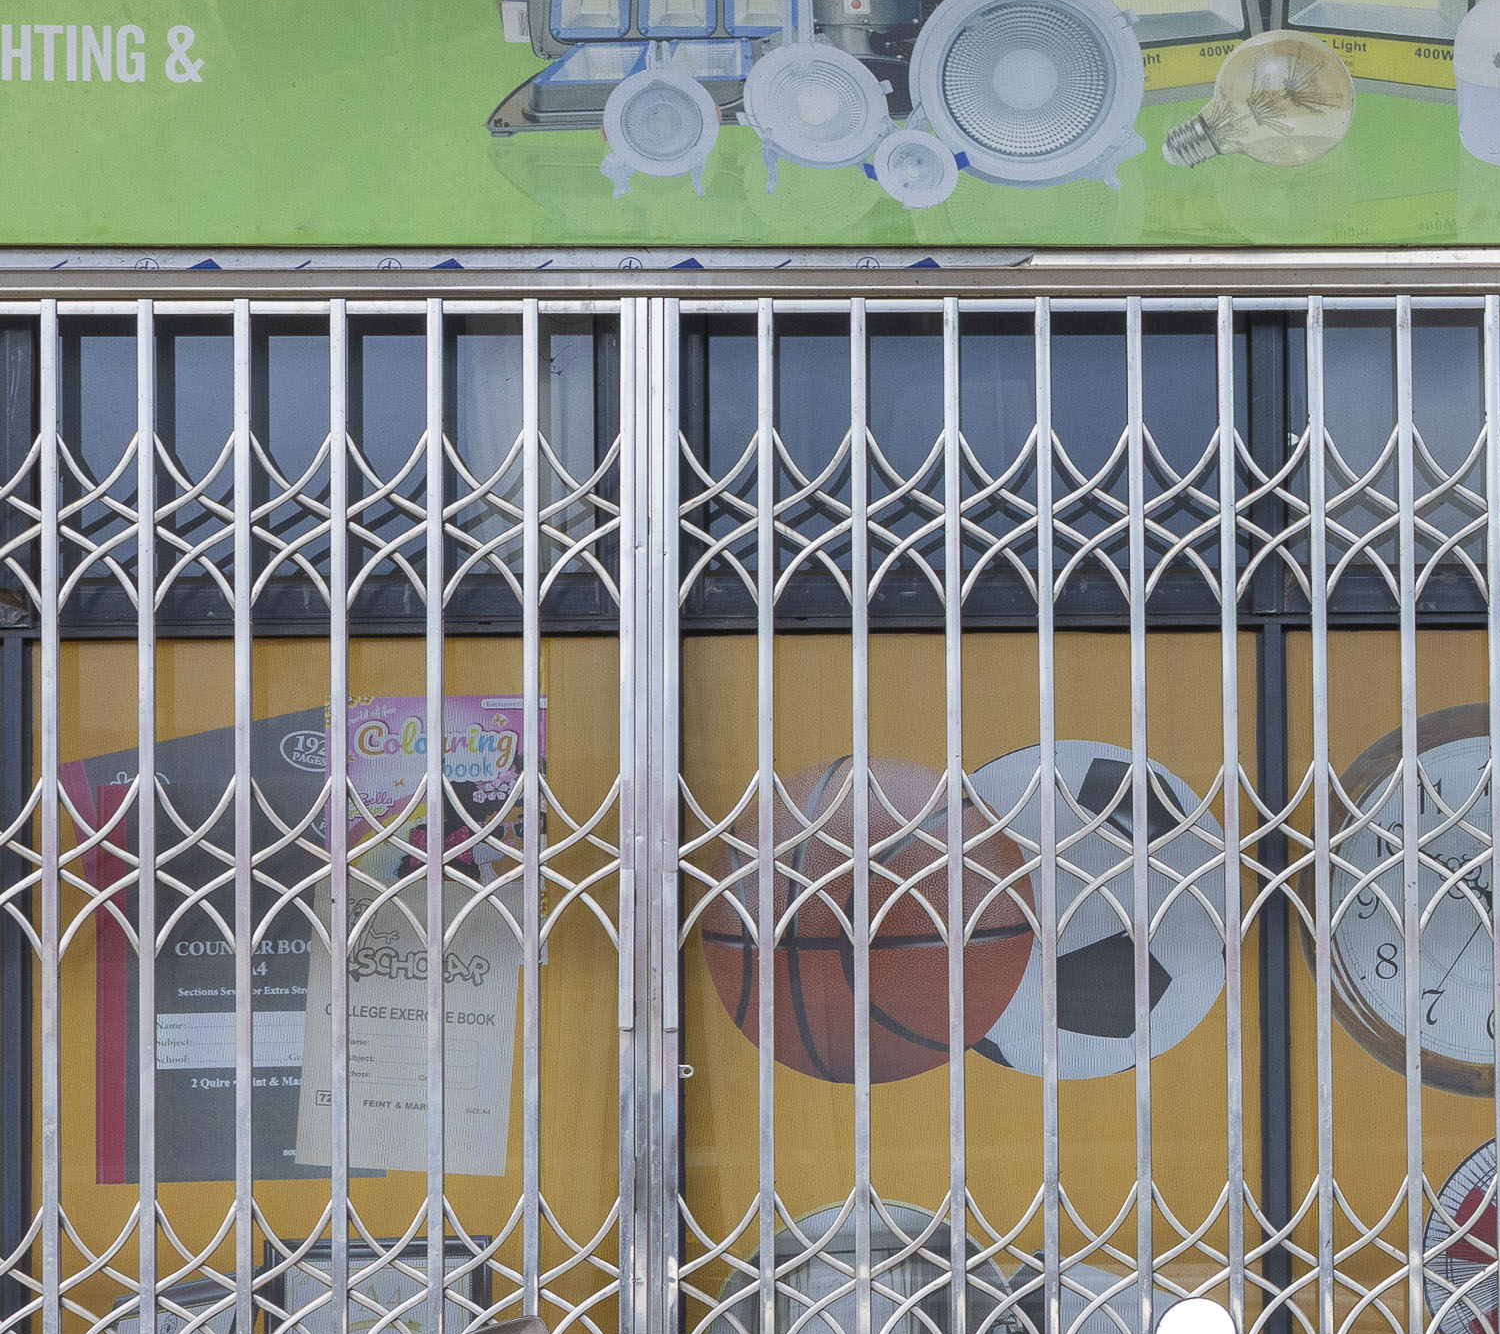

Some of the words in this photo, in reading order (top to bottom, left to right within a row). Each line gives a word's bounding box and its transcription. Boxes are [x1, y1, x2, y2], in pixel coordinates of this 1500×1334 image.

[1, 24, 146, 84] HTING
[165, 24, 205, 84] &
[1332, 38, 1368, 54] Light
[1414, 47, 1454, 63] 400W
[292, 751, 327, 767] PAGES
[356, 947, 491, 988] SCHOAR
[1375, 942, 1399, 980] 8
[177, 986, 218, 998] Sections
[1421, 988, 1445, 1026] 7
[457, 1011, 496, 1027] BOOK
[191, 1078, 198, 1089] 2
[200, 1077, 231, 1090] Quire
[362, 1099, 393, 1110] FEINT
